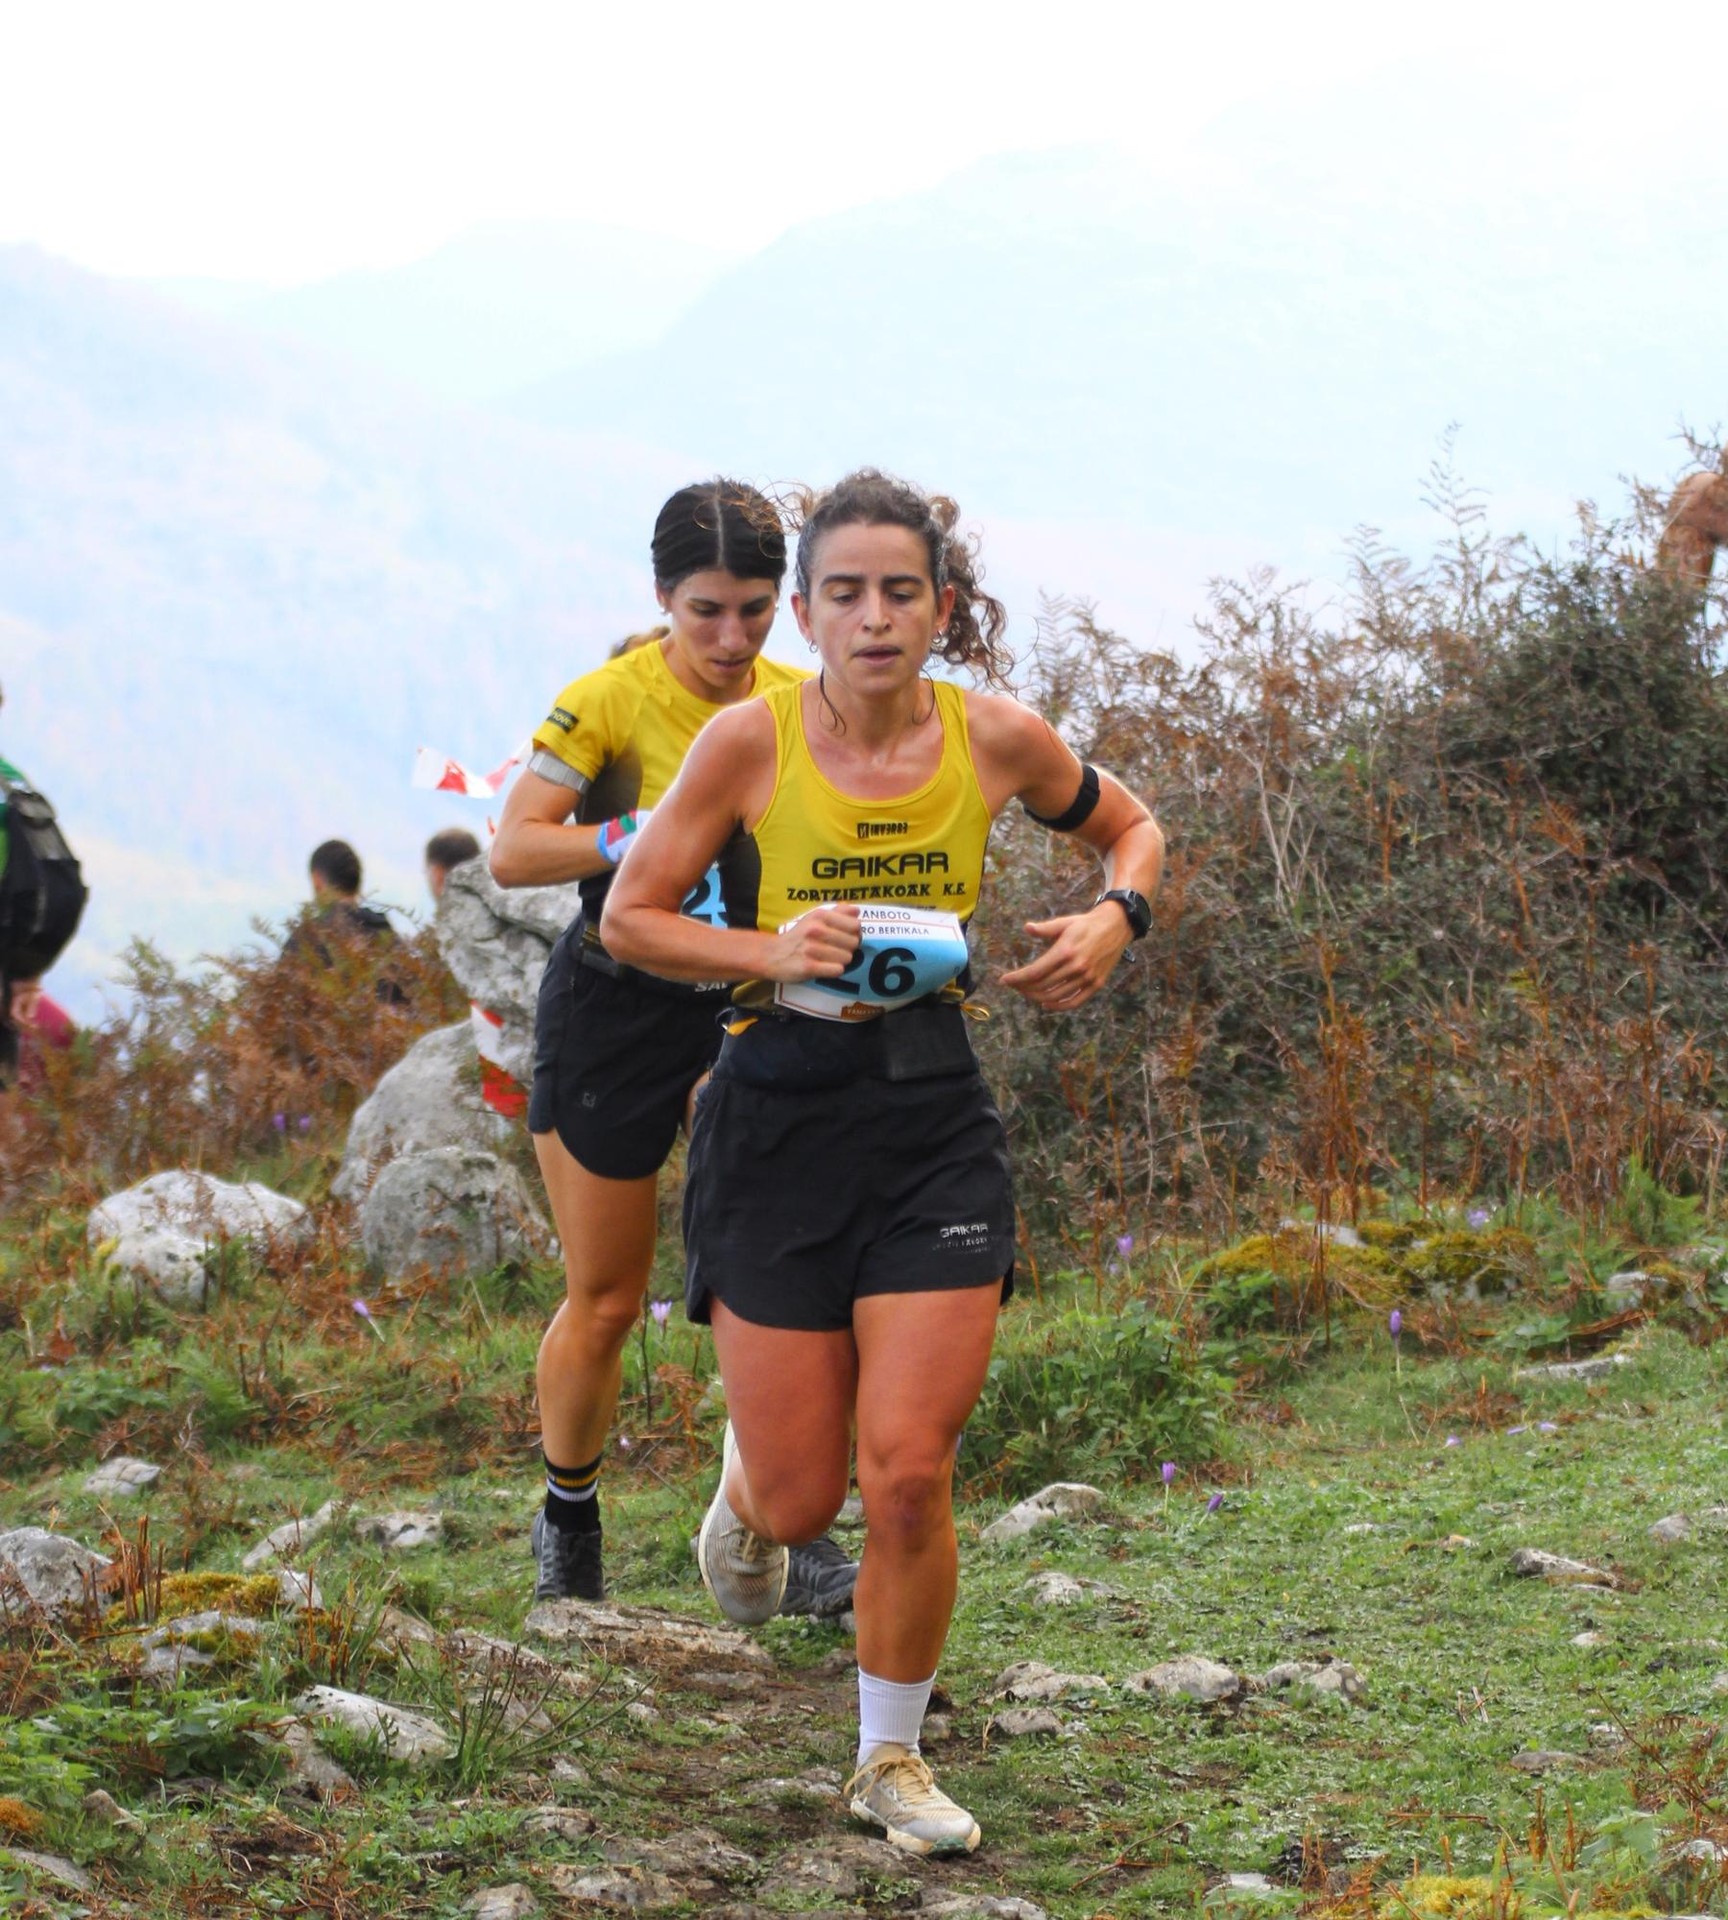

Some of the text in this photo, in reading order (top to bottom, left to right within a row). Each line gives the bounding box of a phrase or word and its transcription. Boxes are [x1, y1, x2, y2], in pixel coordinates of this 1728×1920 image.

[811, 852, 949, 879] GAIKAR
[786, 884, 932, 903] ZORTZIETAKOAK
[862, 910, 912, 921] ANBOTO
[878, 926, 930, 936] BERTIKALA
[814, 946, 917, 998] 26
